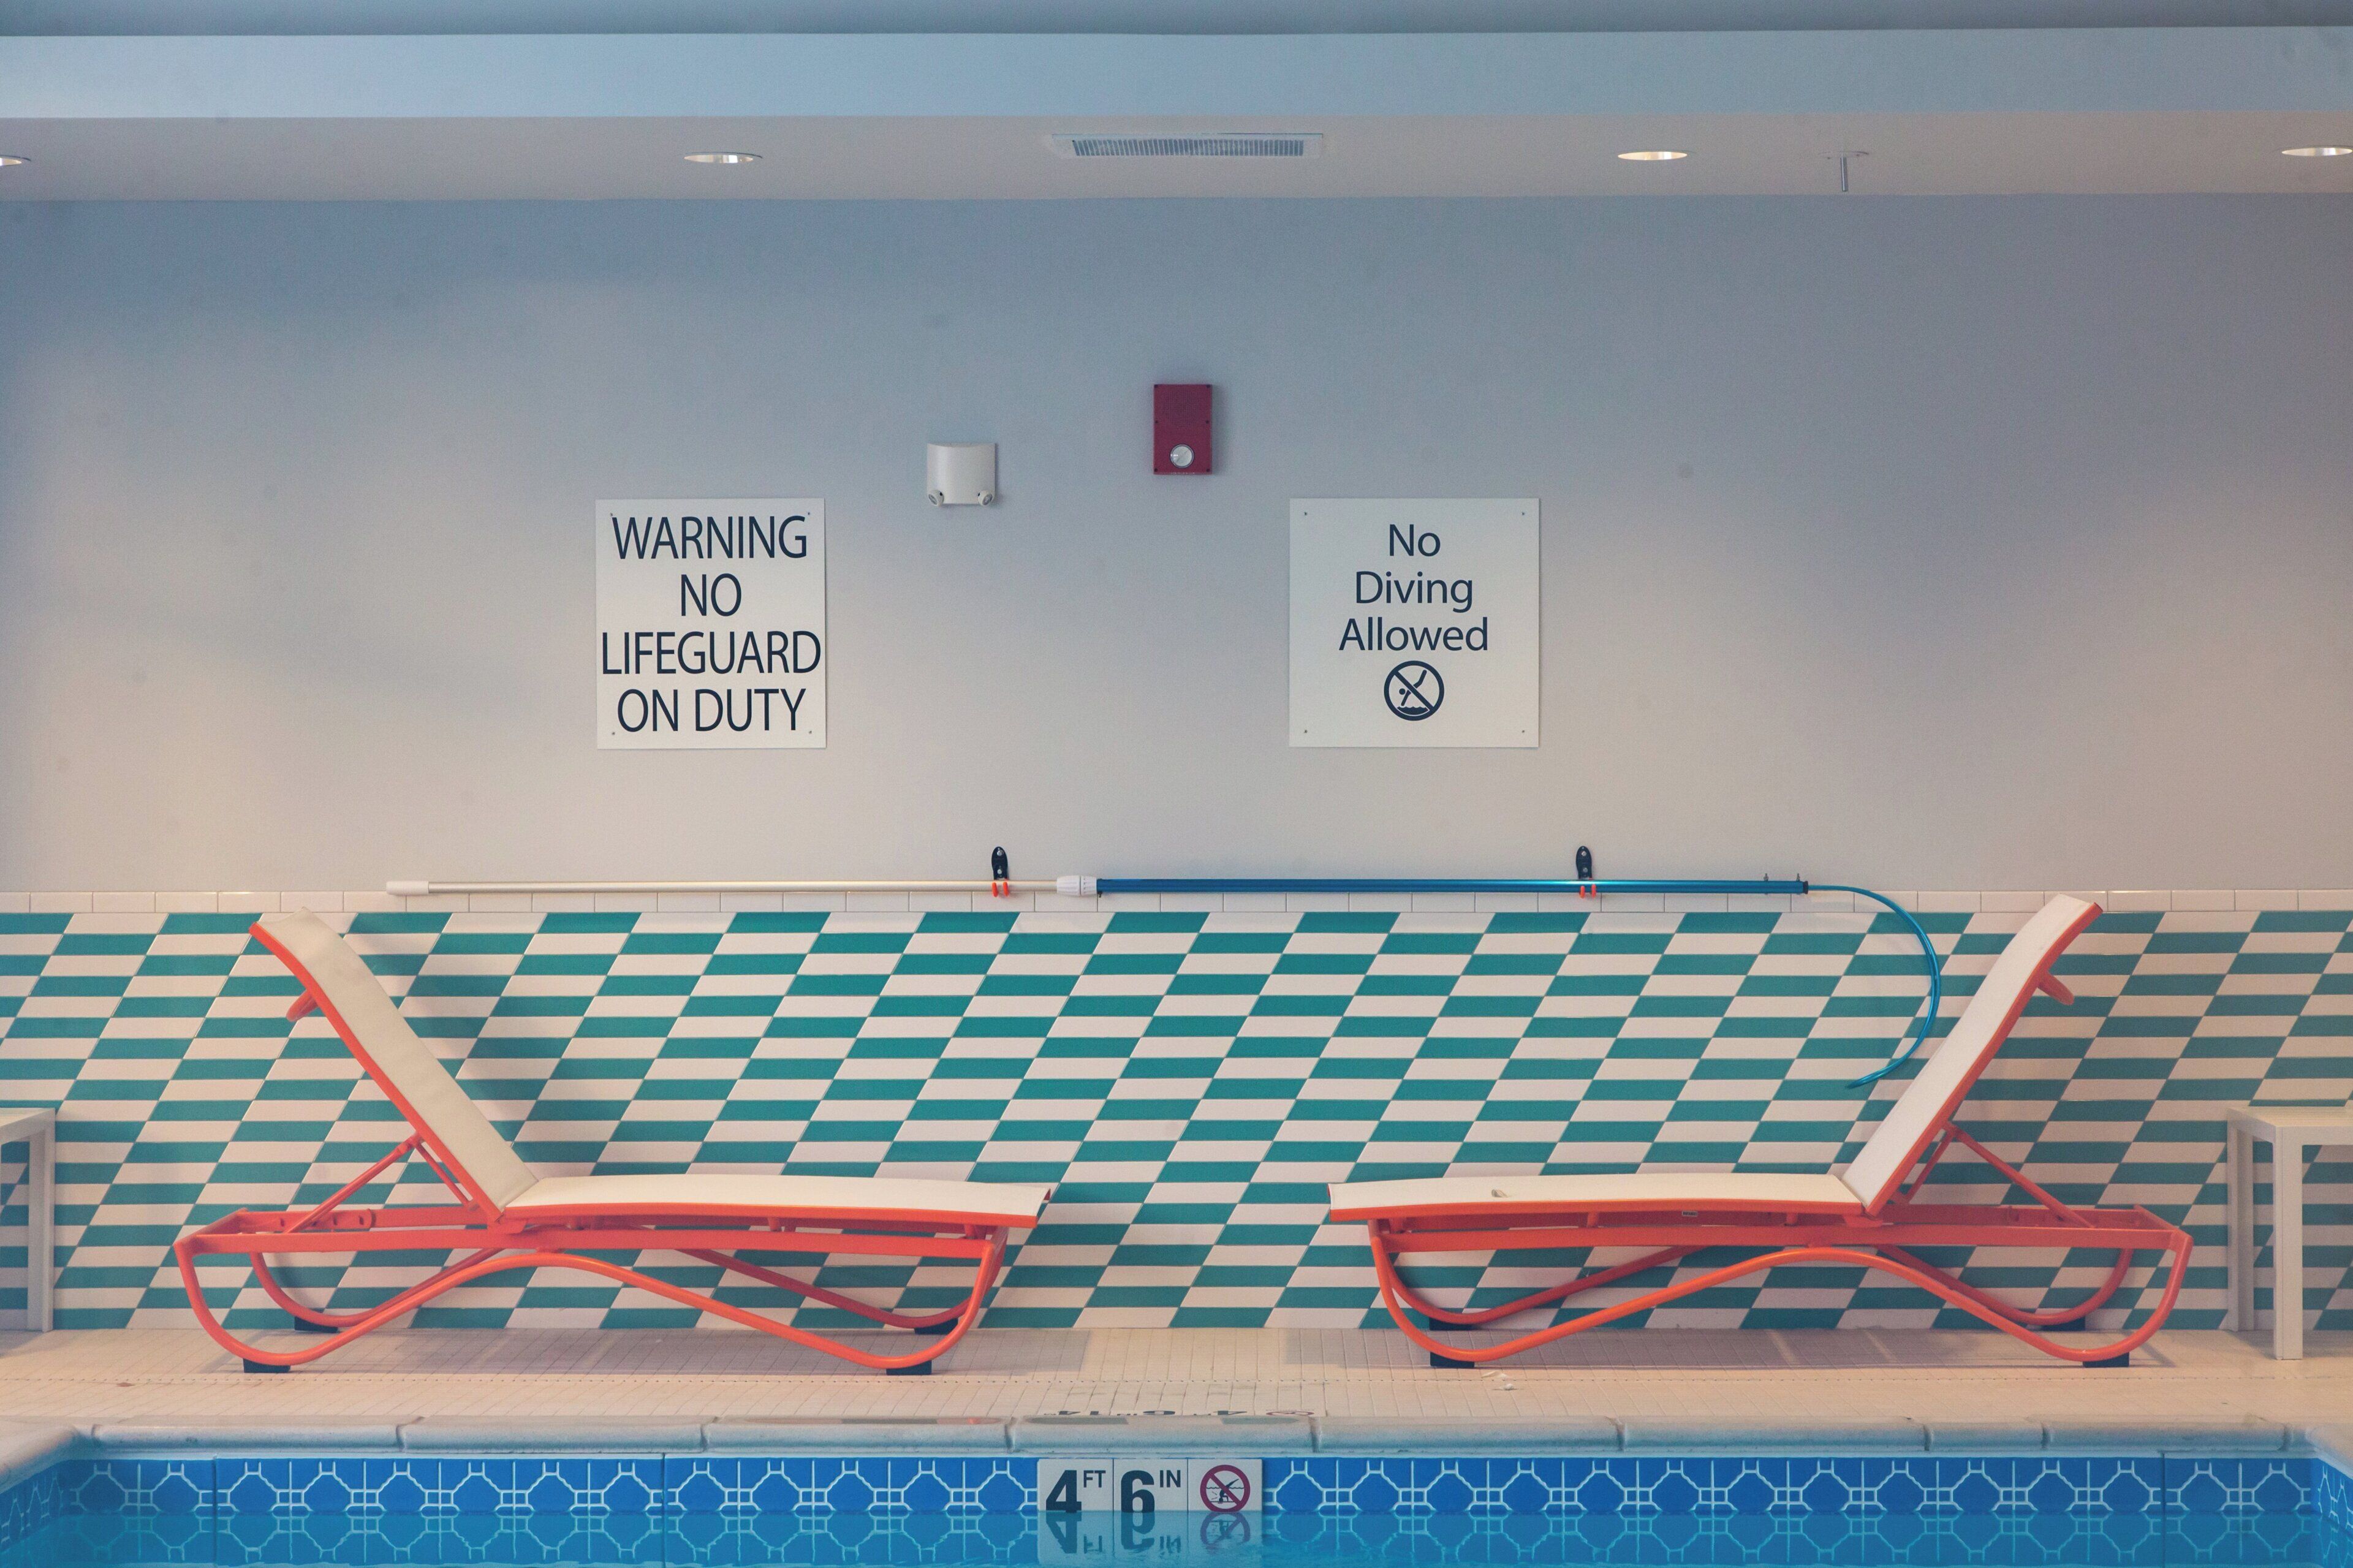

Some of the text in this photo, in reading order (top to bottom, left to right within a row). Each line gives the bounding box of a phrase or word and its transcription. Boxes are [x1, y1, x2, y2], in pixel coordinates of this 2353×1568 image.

[612, 515, 807, 559] WARNING
[1389, 524, 1441, 557] No
[681, 573, 742, 617] NO
[1355, 570, 1472, 613] Diving
[602, 631, 821, 675] LIFEGUARD
[1338, 616, 1488, 651] Allowed
[618, 688, 806, 732] ON DUTY
[1045, 1469, 1181, 1513] 4 FT 6 IN
